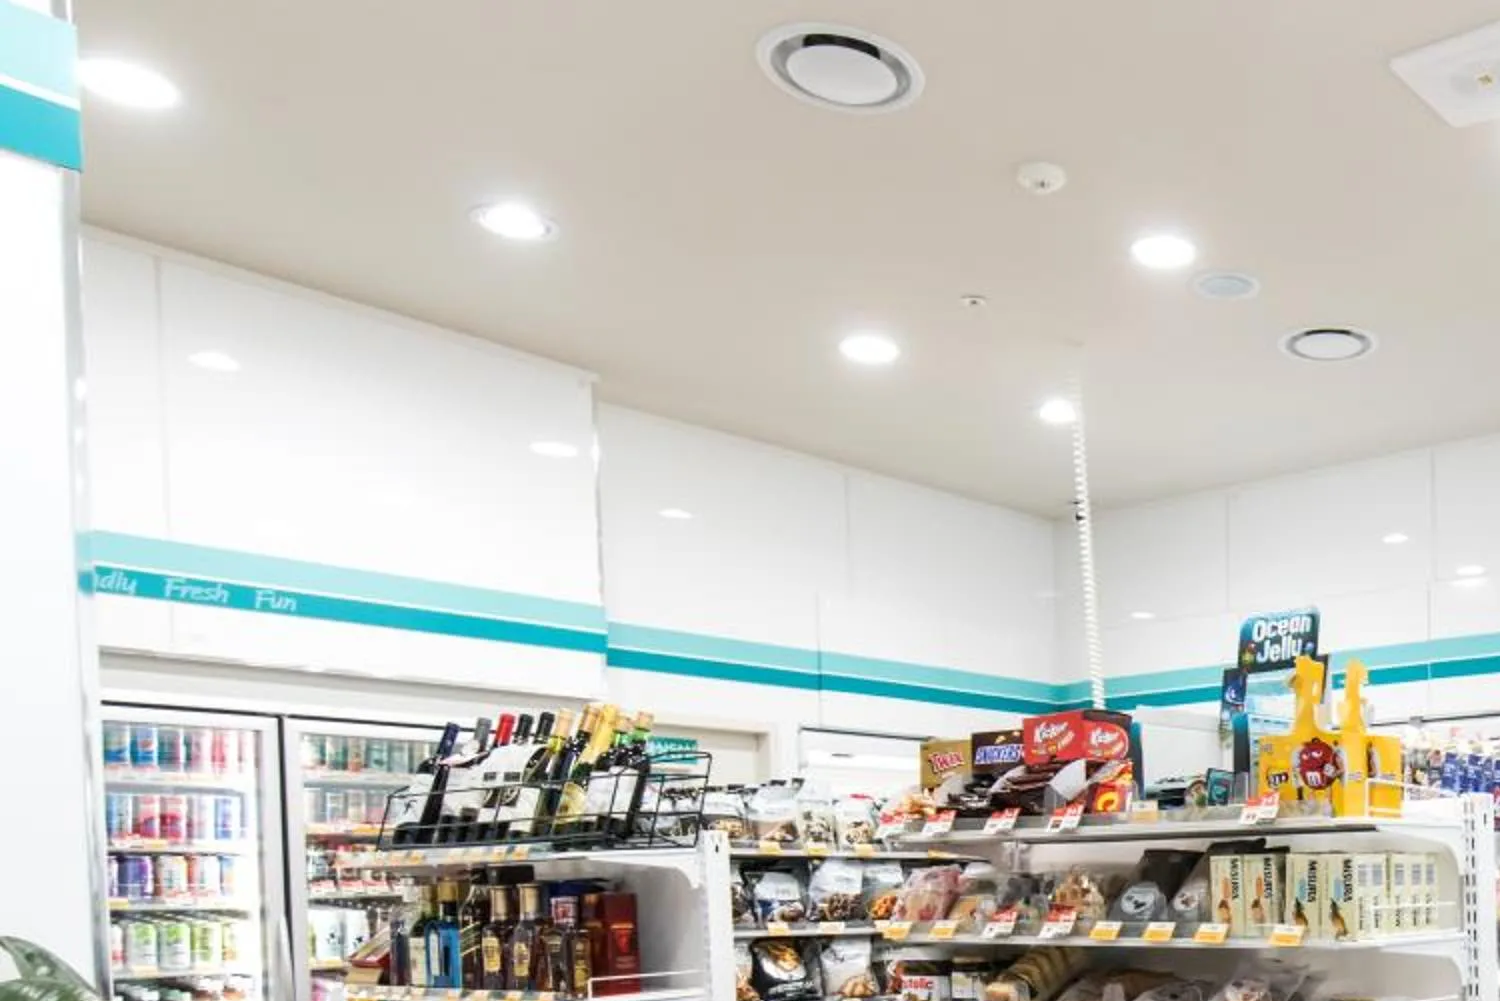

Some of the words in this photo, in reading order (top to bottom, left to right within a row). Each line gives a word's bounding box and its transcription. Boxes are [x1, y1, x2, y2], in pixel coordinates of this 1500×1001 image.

[163, 577, 231, 603] Fresh
[255, 589, 297, 612] Fun
[1254, 613, 1312, 643] Ocean
[1256, 637, 1303, 663] Jelly
